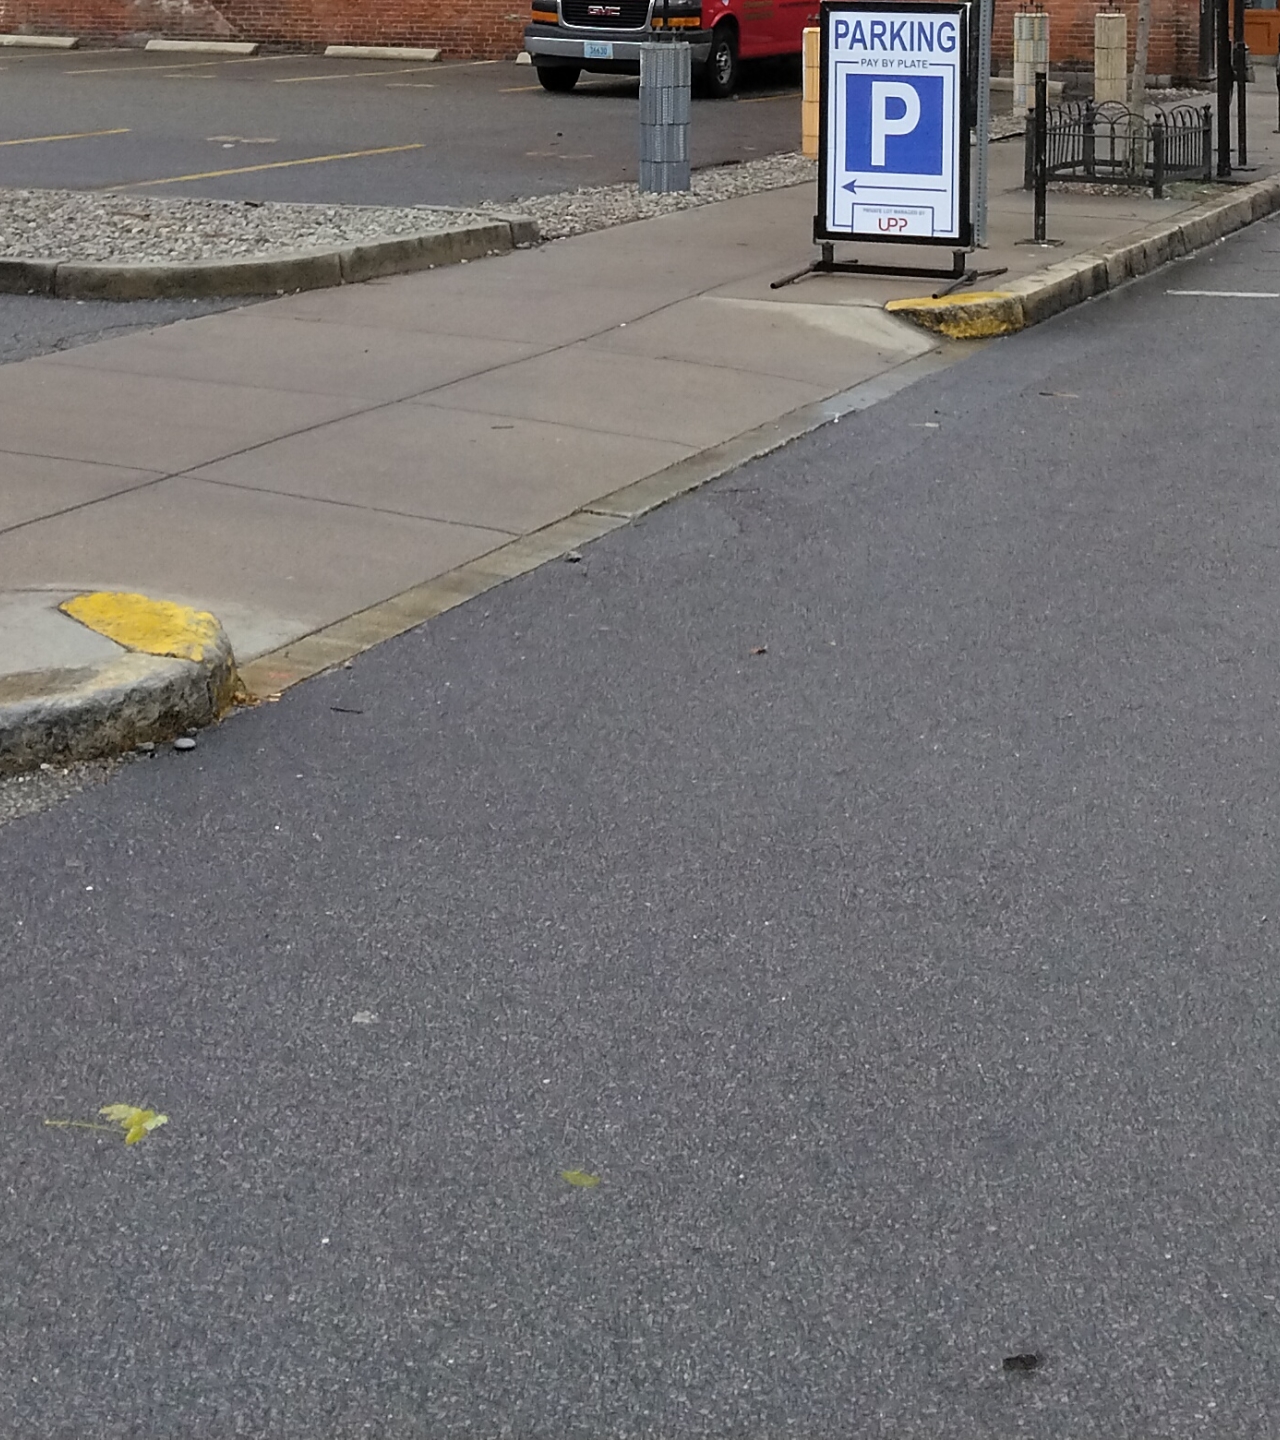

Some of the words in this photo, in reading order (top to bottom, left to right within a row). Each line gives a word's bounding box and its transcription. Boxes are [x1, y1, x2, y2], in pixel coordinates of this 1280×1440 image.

[587, 6, 621, 16] GMC
[835, 19, 956, 53] PARKING
[860, 59, 879, 67] PAY
[882, 59, 895, 68] BY
[897, 60, 928, 69] PLATE
[871, 80, 921, 167] P
